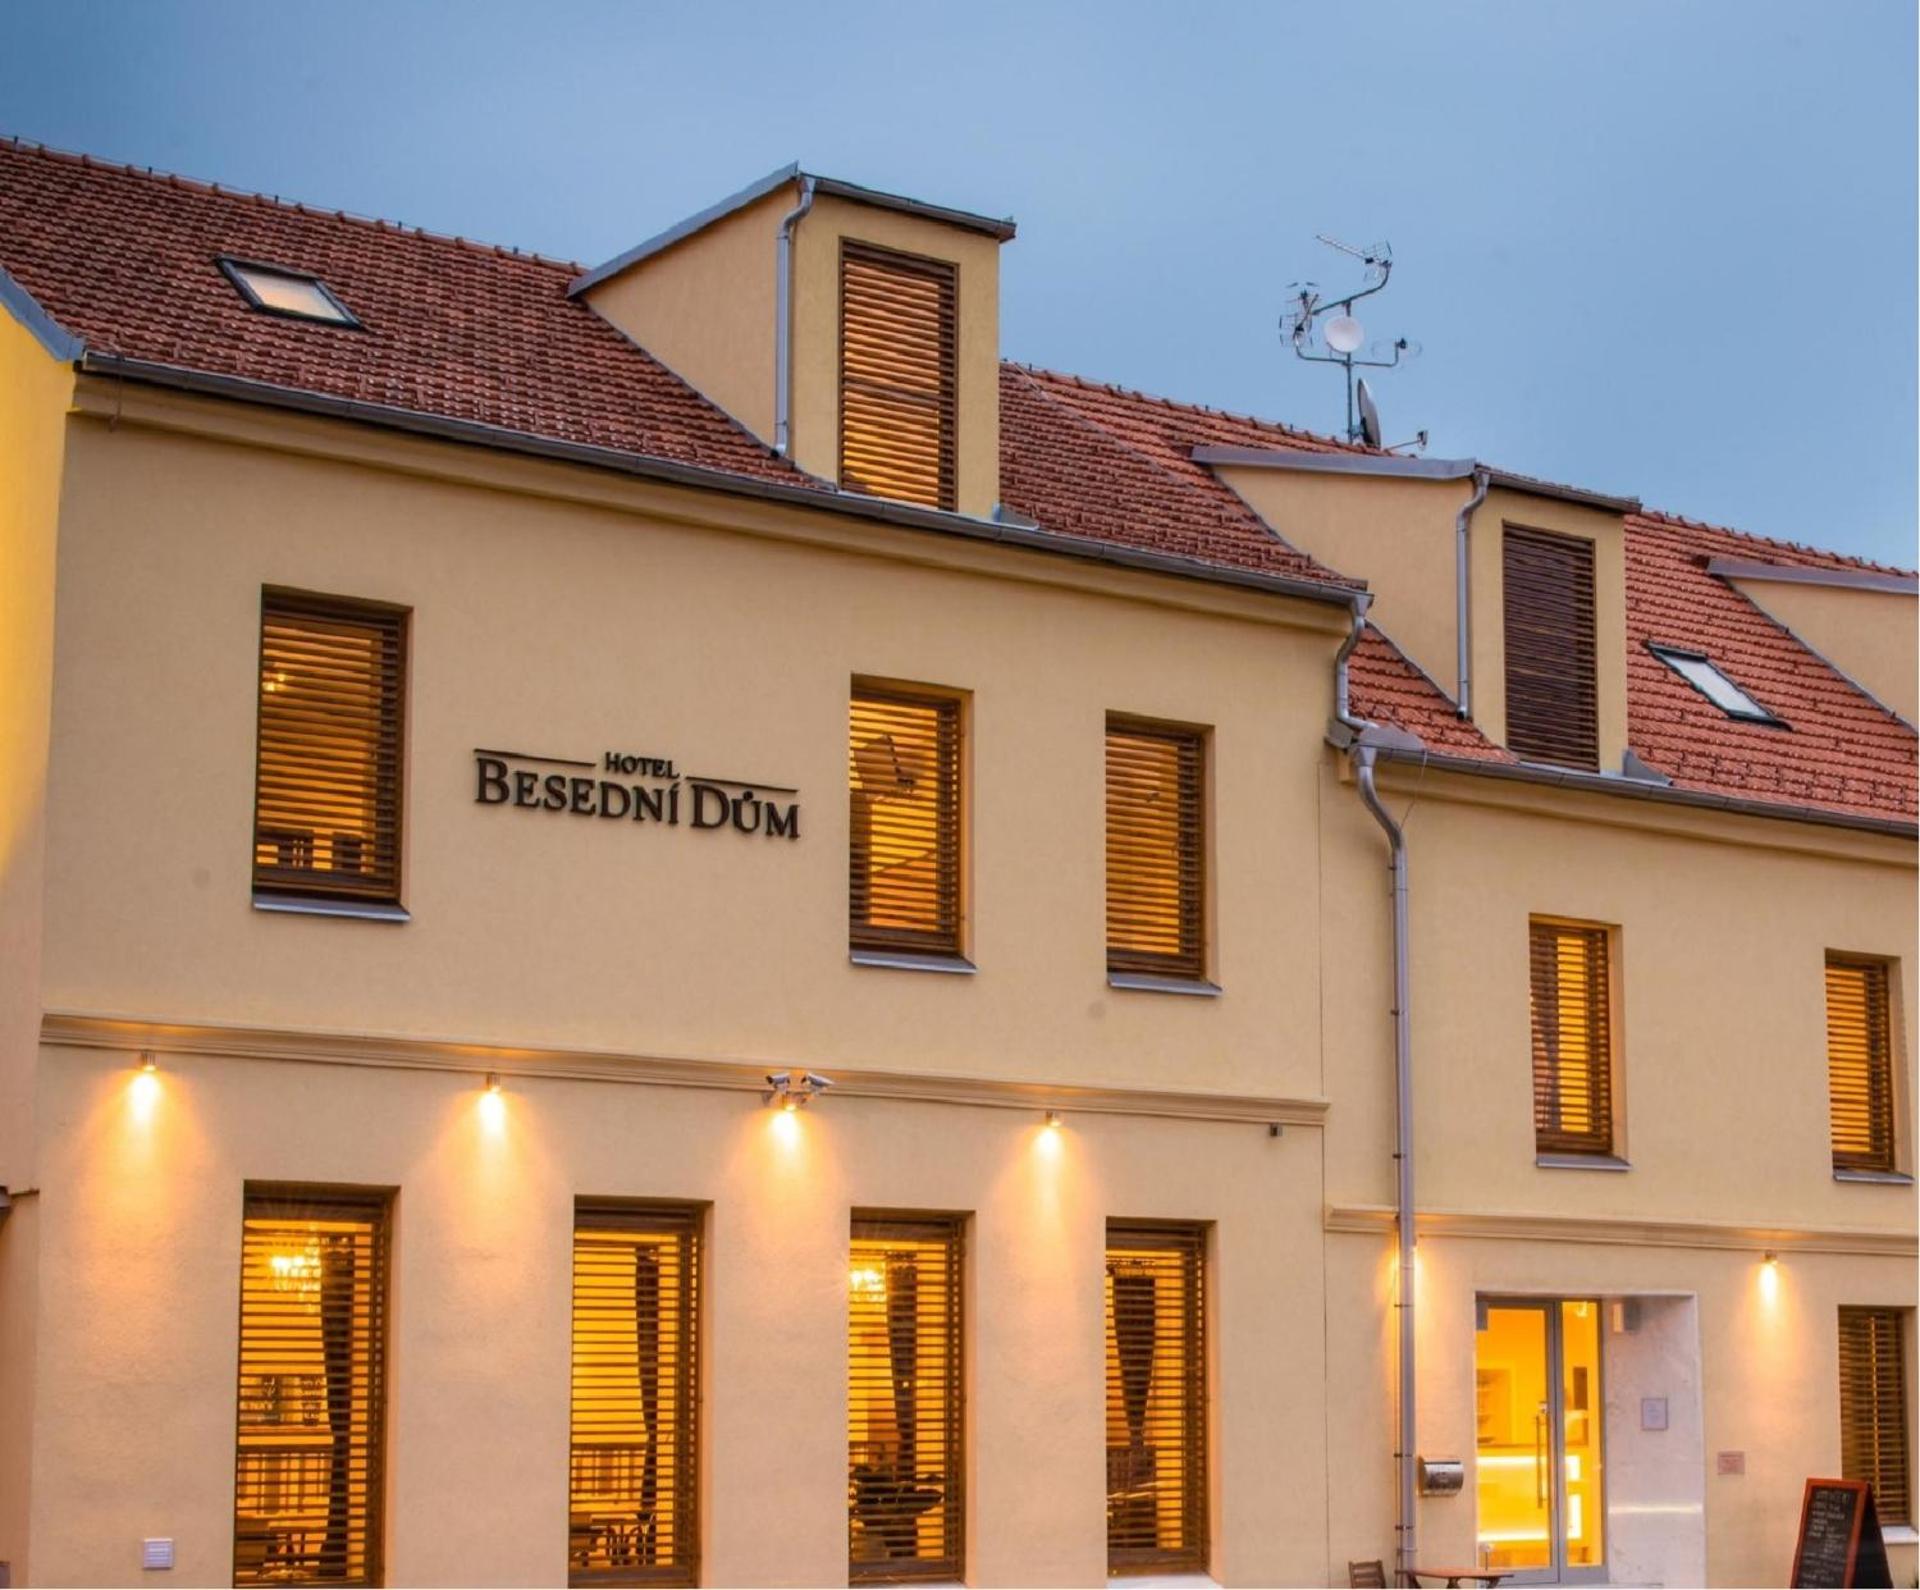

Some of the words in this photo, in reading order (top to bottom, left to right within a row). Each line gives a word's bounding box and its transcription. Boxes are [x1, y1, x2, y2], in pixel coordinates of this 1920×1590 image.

[604, 751, 680, 779] HOTEL
[474, 757, 680, 825] BESEDNÍ
[690, 783, 800, 839] DŮM
